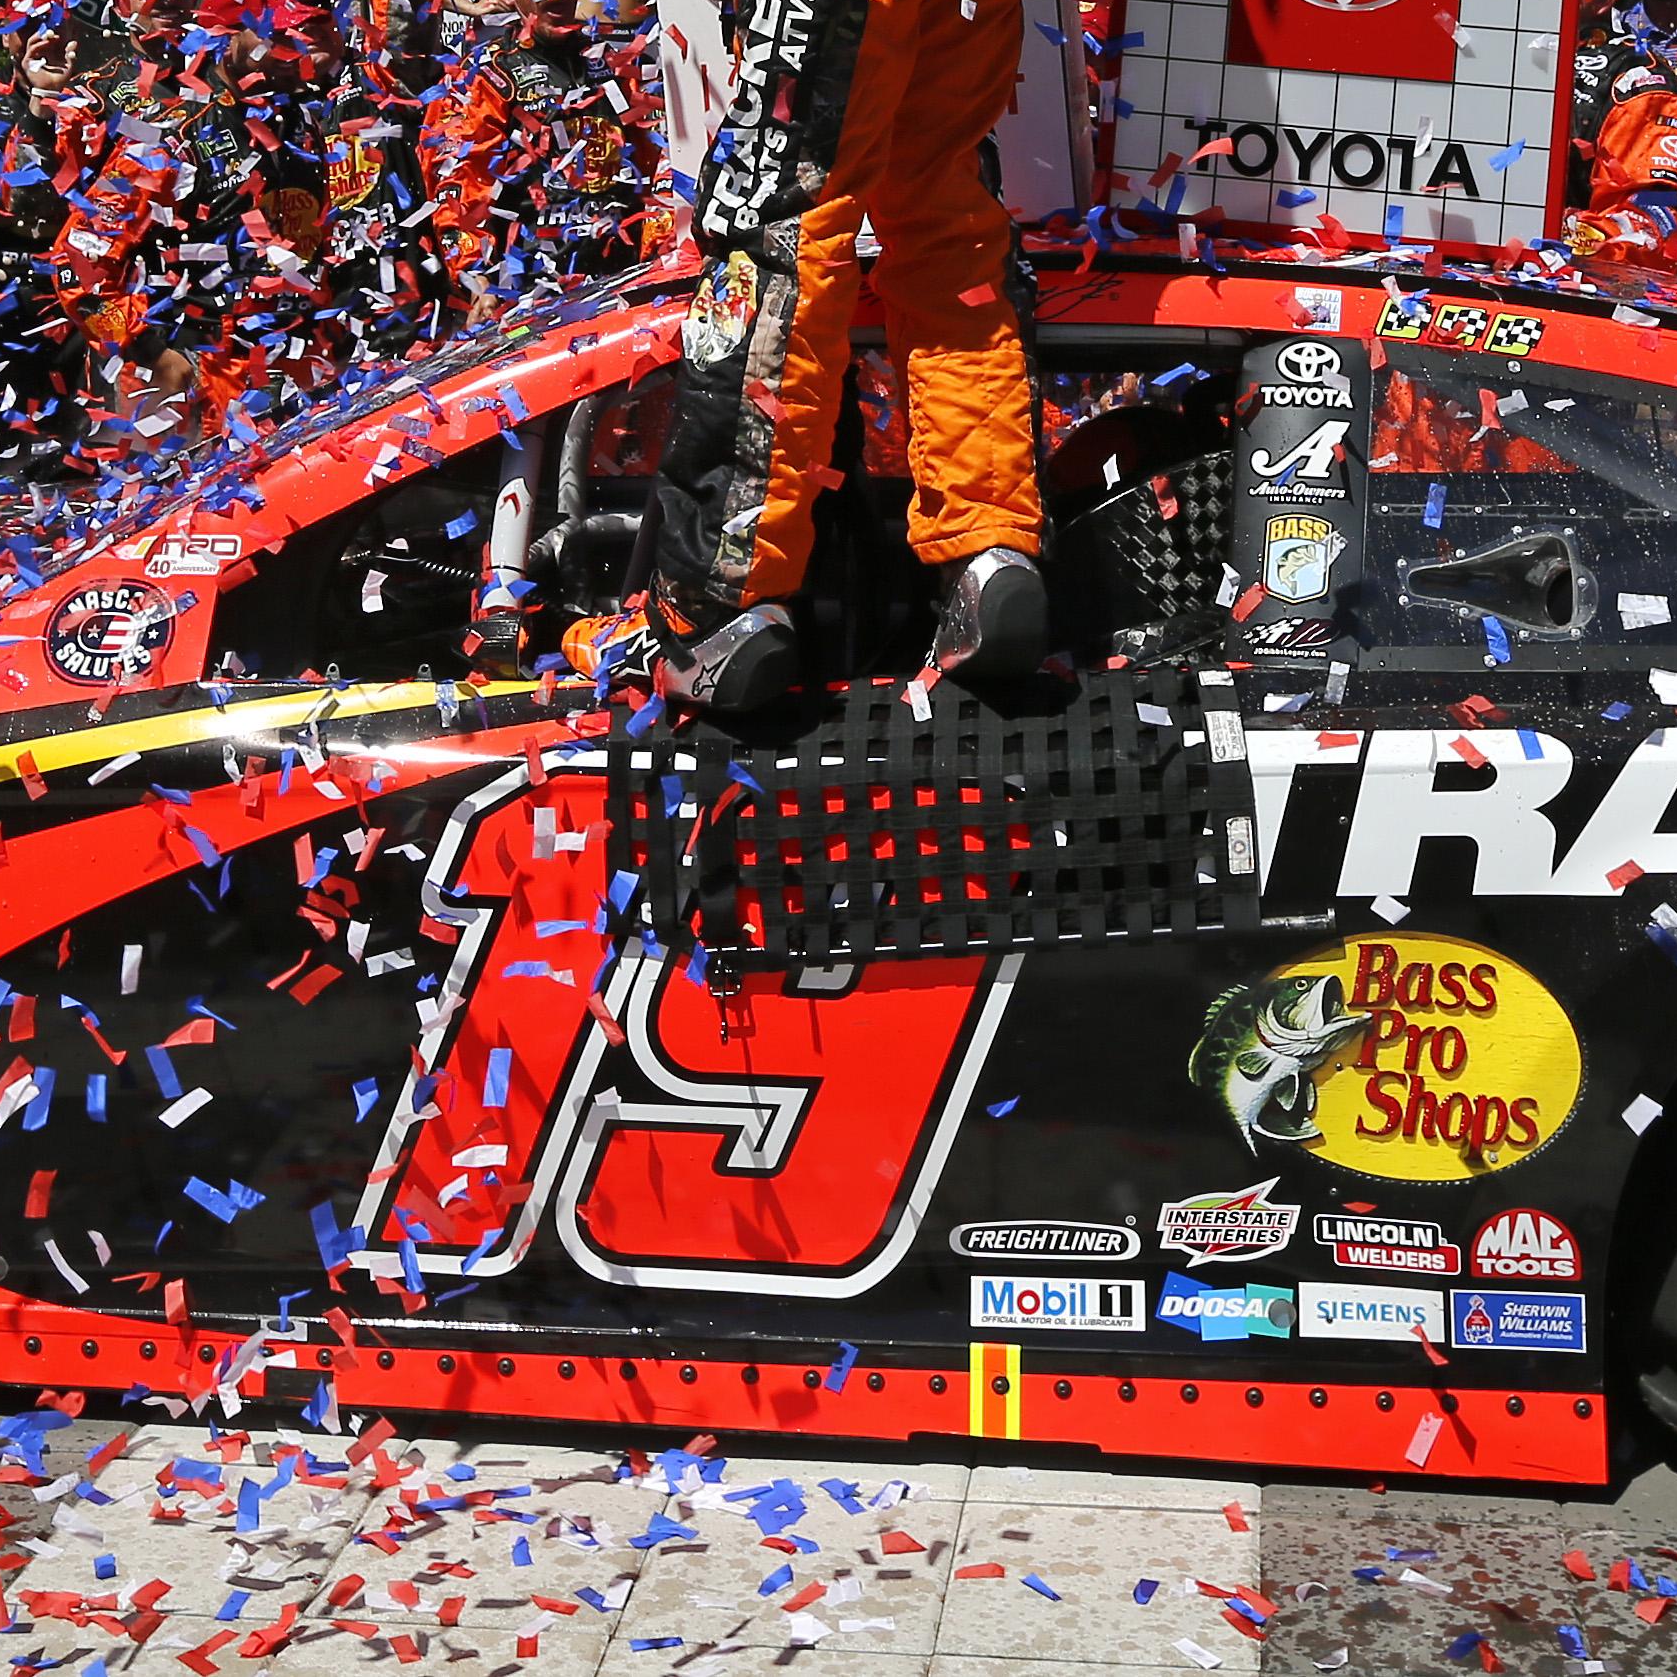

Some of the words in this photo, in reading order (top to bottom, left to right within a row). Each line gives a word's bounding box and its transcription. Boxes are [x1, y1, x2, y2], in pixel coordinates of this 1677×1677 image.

[1184, 118, 1480, 197] TOYOTA
[1261, 386, 1353, 409] TOYOTA
[1249, 481, 1346, 500] Auto-Owners
[1269, 495, 1323, 505] INSURANCE
[1270, 518, 1328, 542] BASS
[148, 560, 171, 575] 40
[1346, 943, 1497, 1012] Bass
[348, 748, 1025, 1299] 19
[1352, 1009, 1468, 1075] Pro
[1355, 1070, 1539, 1163] Shops
[1167, 1210, 1290, 1226] INTERSTATE
[967, 1229, 1122, 1252] FREIGHTLINER
[1171, 1227, 1283, 1243] BATTERIES
[1322, 1219, 1434, 1249] LINCOLN
[1476, 1212, 1575, 1259] MAC
[1345, 1246, 1447, 1271] WELDERS
[1476, 1258, 1576, 1278] TOOLS
[982, 1279, 1087, 1316] Mobil
[1106, 1285, 1122, 1318] 1
[1160, 1296, 1273, 1319] DOOSA
[981, 1315, 1019, 1325] OFFICIAL
[1021, 1316, 1052, 1326] MOTOR
[1054, 1317, 1068, 1326] OIL
[1079, 1318, 1134, 1327] LUBRICANTS
[1316, 1300, 1427, 1324] SIEMENS
[1502, 1302, 1571, 1319] SHERWIN
[1498, 1316, 1572, 1333] WILLIAMS
[1500, 1330, 1541, 1340] Automotive
[1542, 1332, 1574, 1341] Finishes
